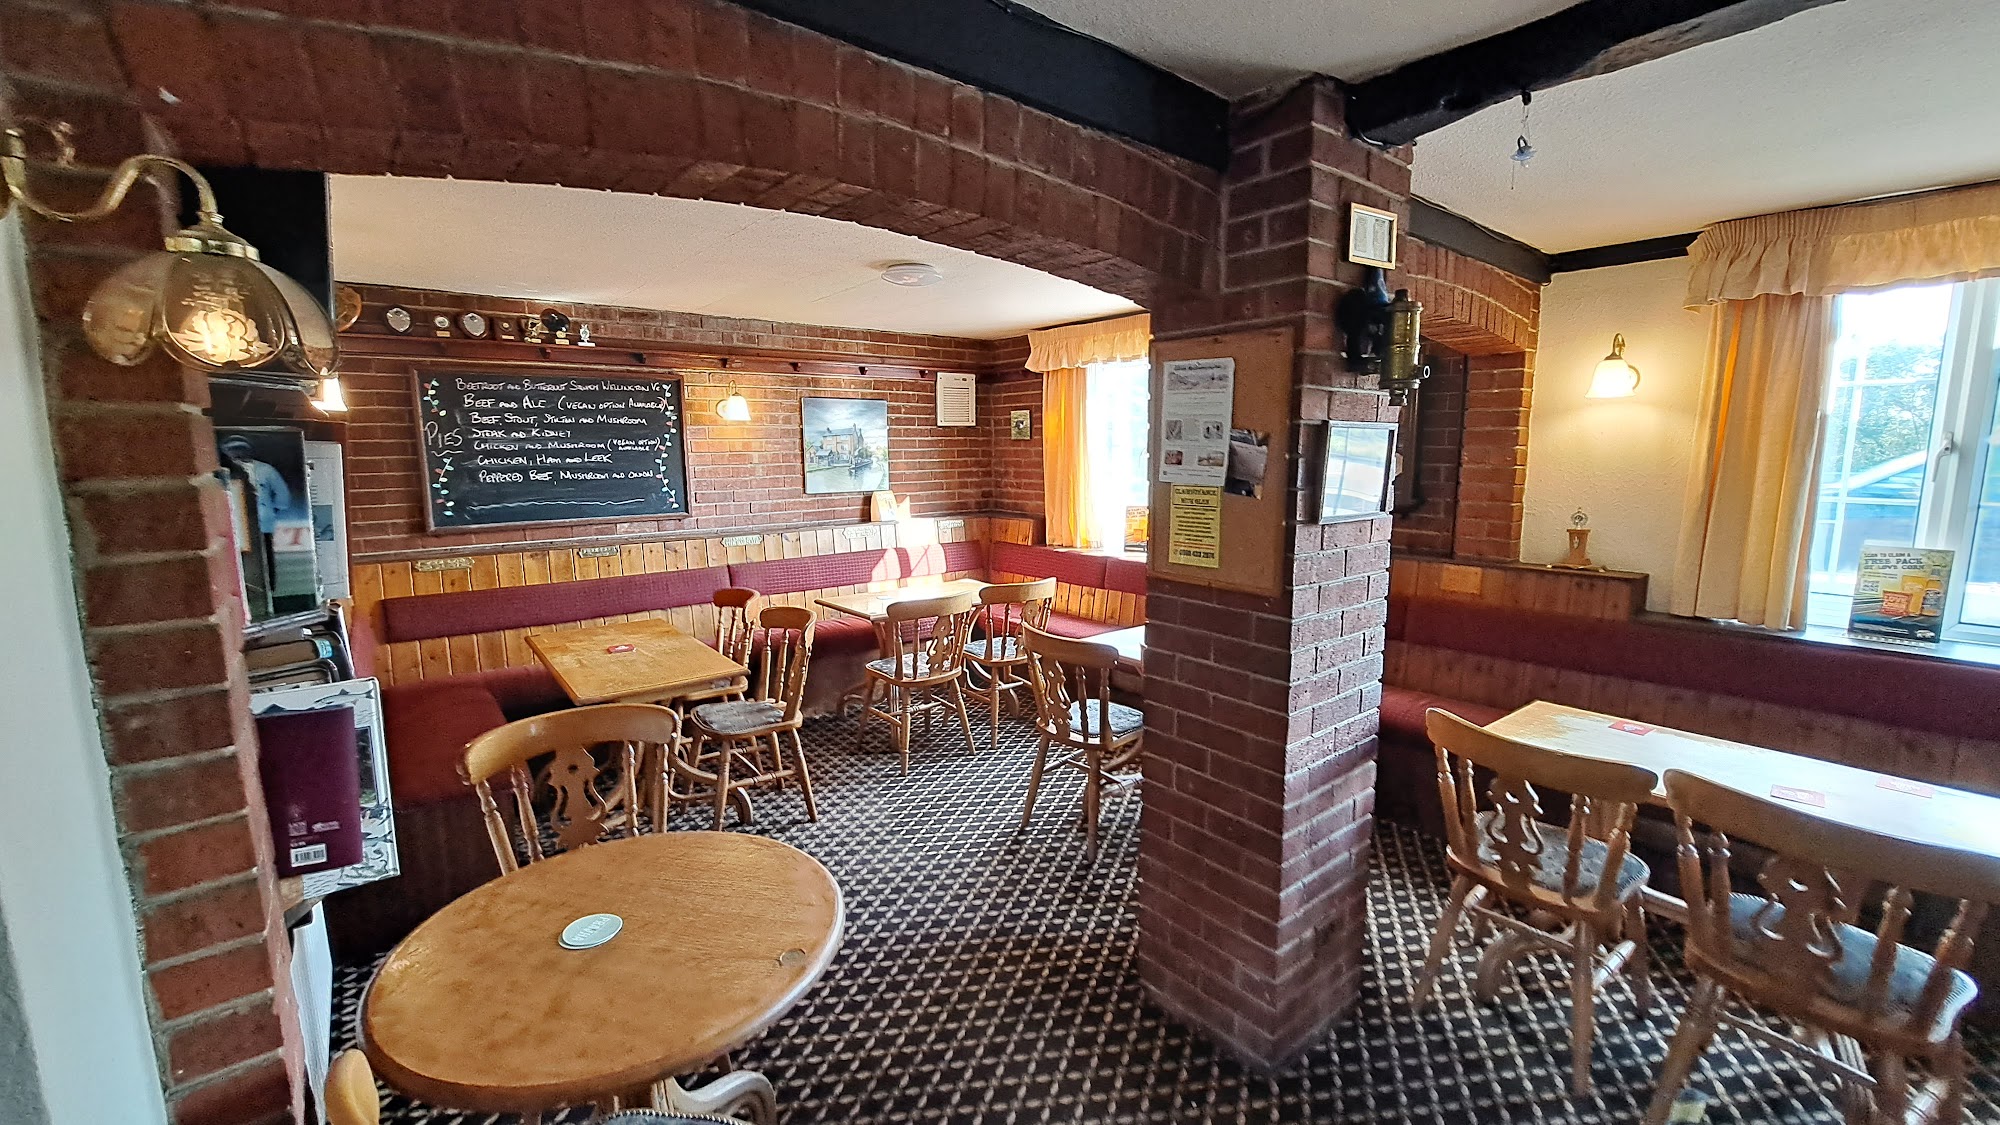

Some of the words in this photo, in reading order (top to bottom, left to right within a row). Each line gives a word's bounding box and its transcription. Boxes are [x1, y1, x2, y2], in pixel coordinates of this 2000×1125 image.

[455, 377, 505, 391] BEETROOT
[507, 383, 521, 391] AND
[463, 392, 495, 408] BEEF
[499, 400, 518, 409] AND
[522, 394, 547, 410] ALE
[596, 414, 648, 426] MUSHROOM
[424, 420, 463, 449] PIES
[471, 427, 507, 438] STEAK
[531, 427, 571, 438] KIDNEY
[473, 441, 519, 451] CHICKEN
[547, 441, 606, 450] MUSHROOM
[477, 454, 533, 466] CHICKEN,
[536, 453, 562, 465] HAM
[584, 452, 613, 464] LEEK
[479, 469, 524, 483] PEPPERED
[559, 470, 610, 480] MUSHROOM
[627, 470, 654, 479] ONION
[1895, 557, 1923, 565] PACK
